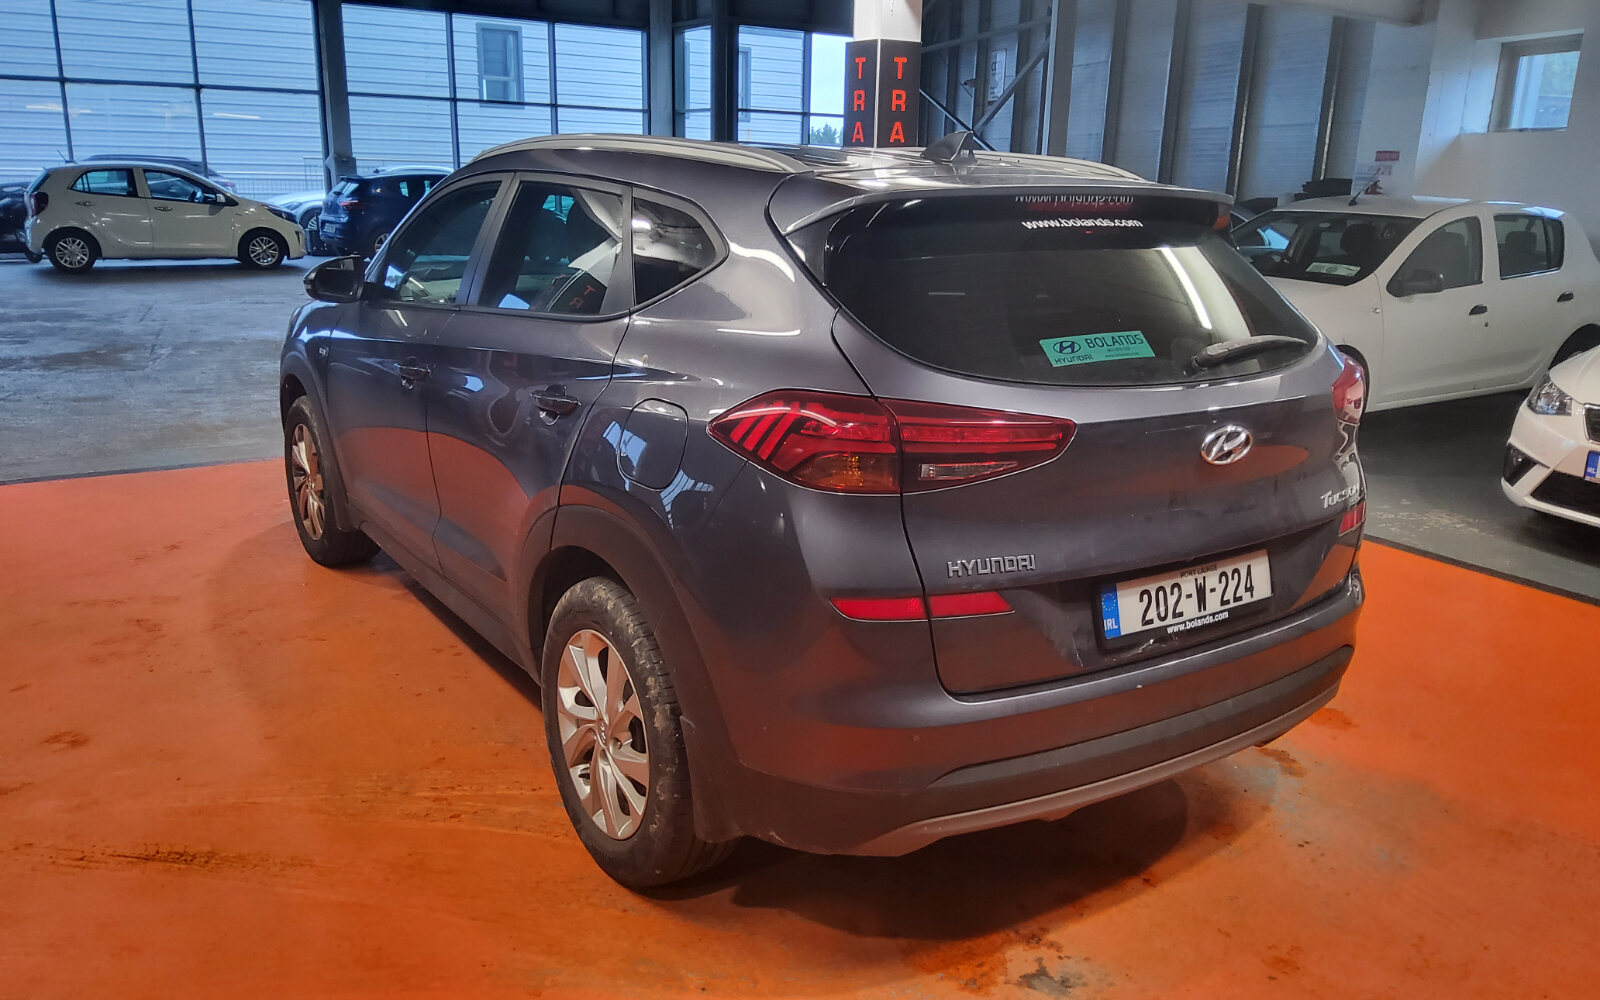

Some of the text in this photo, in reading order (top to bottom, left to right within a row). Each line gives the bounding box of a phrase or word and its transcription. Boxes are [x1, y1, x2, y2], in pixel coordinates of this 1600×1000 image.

[851, 57, 867, 143] TRA
[889, 57, 908, 143] TRA
[1021, 217, 1143, 230] www.bolands.com
[1084, 334, 1144, 349] BOLANDS
[1054, 353, 1094, 365] HYUNDAI
[947, 554, 1036, 578] HYUNDAI
[1139, 564, 1255, 627] 202-W-224
[1103, 618, 1119, 632] IRL
[1166, 611, 1229, 634] www.bolands.com
